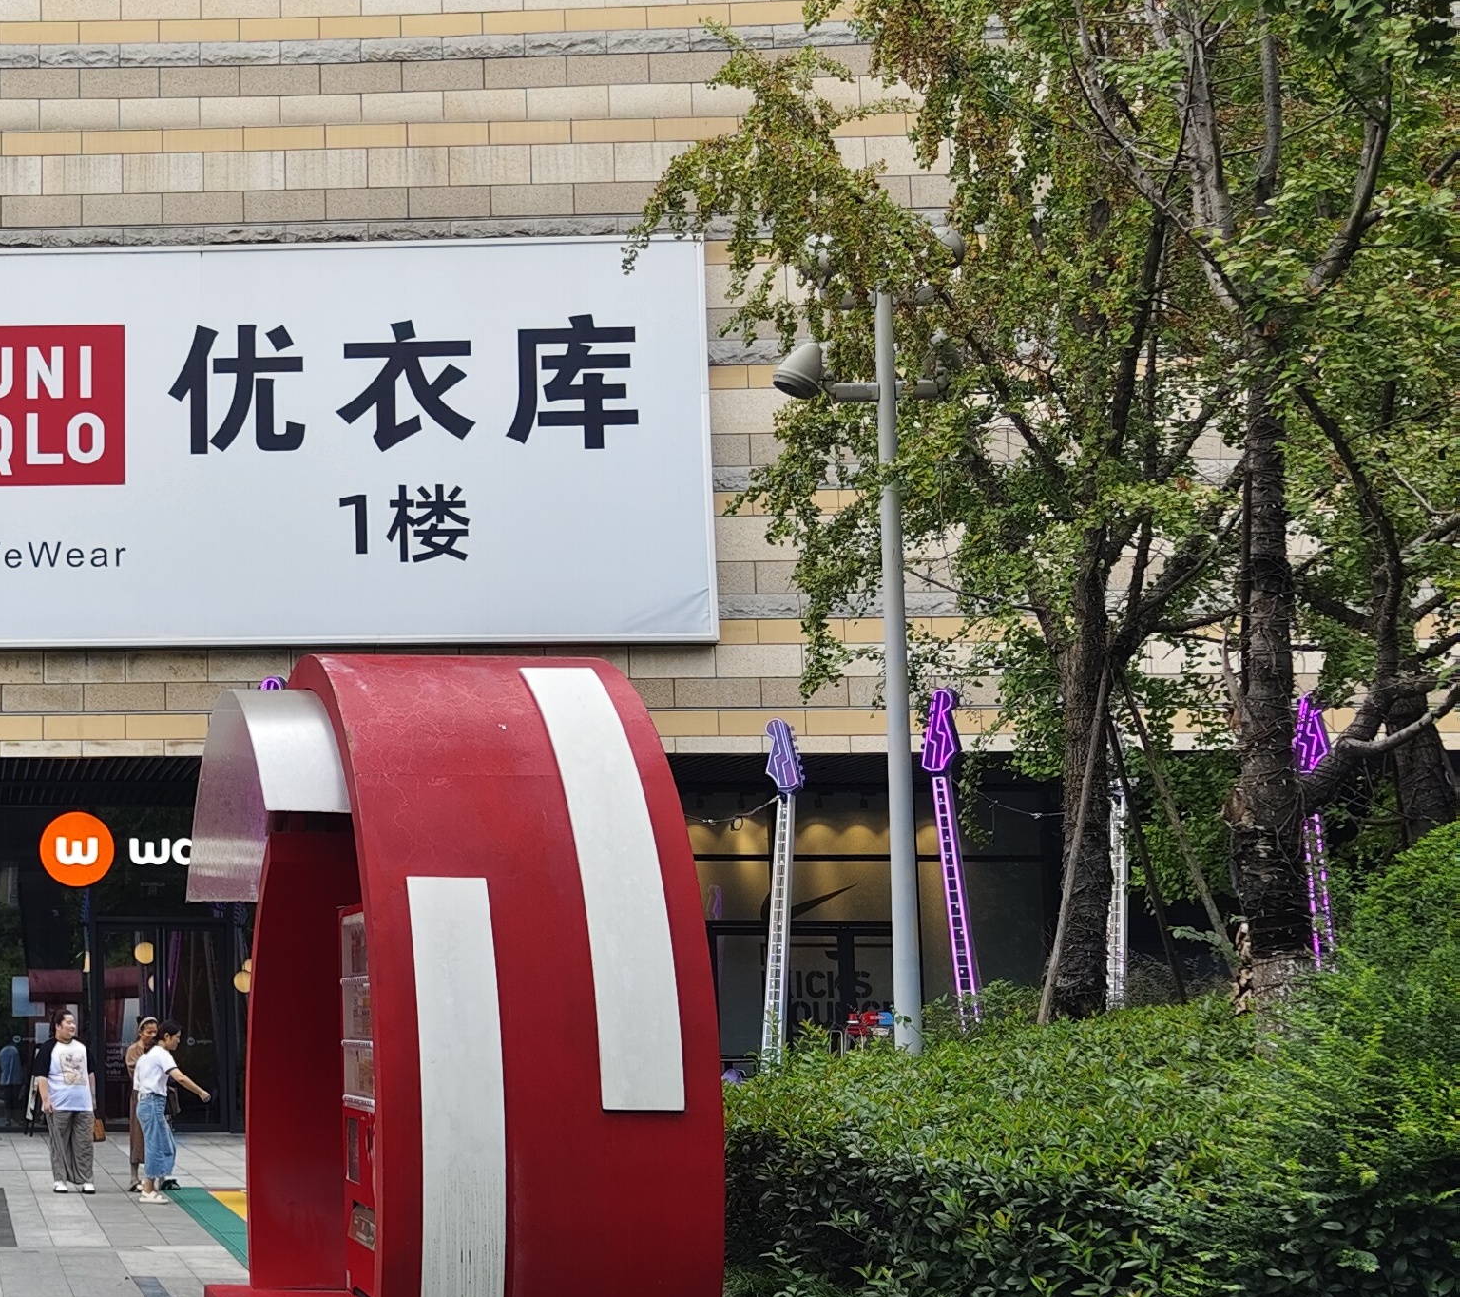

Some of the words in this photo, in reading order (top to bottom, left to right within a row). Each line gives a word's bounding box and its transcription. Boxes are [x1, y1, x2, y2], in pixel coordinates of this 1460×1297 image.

[168, 314, 639, 454] 优衣库
[339, 484, 470, 563] 1楼
